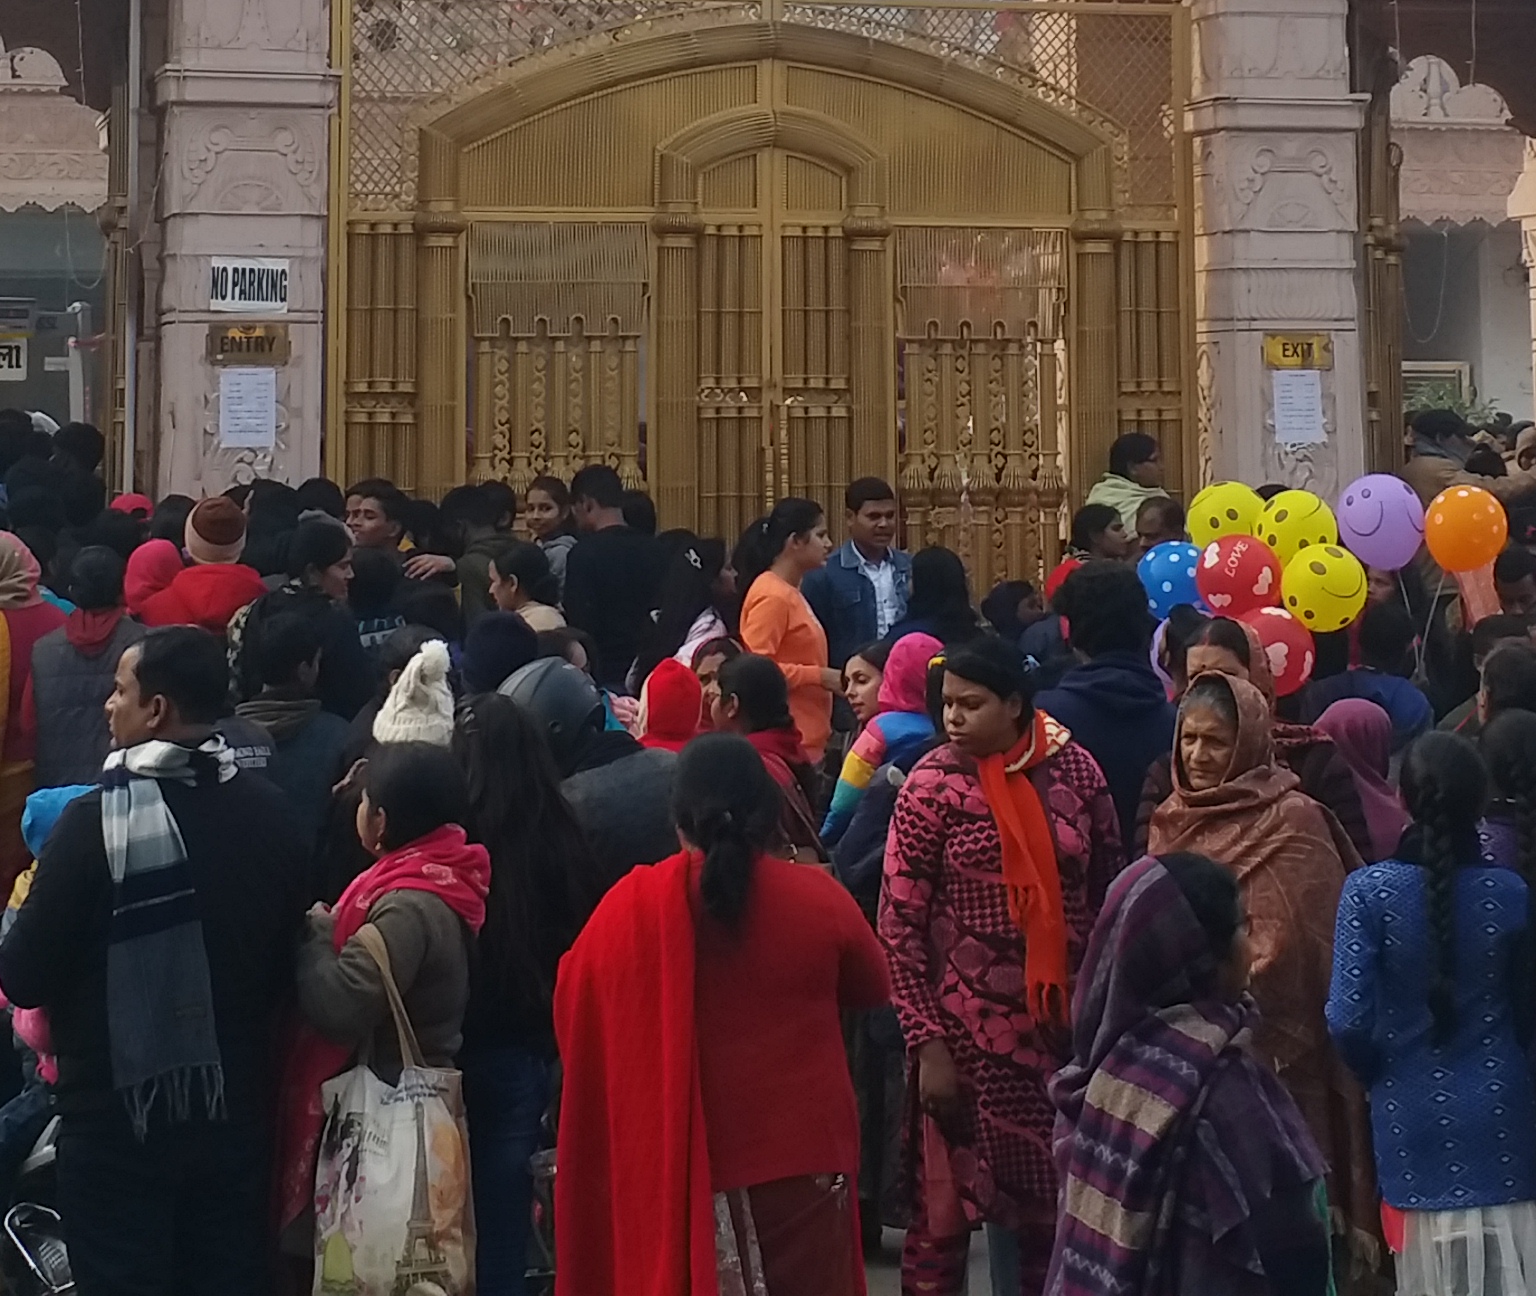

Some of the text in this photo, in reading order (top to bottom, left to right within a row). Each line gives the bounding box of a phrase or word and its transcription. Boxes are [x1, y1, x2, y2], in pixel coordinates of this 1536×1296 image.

[211, 266, 287, 303] NO PARKING
[221, 336, 276, 353] ENTRY
[1282, 342, 1314, 358] EXIT
[1225, 541, 1249, 578] LOVE
